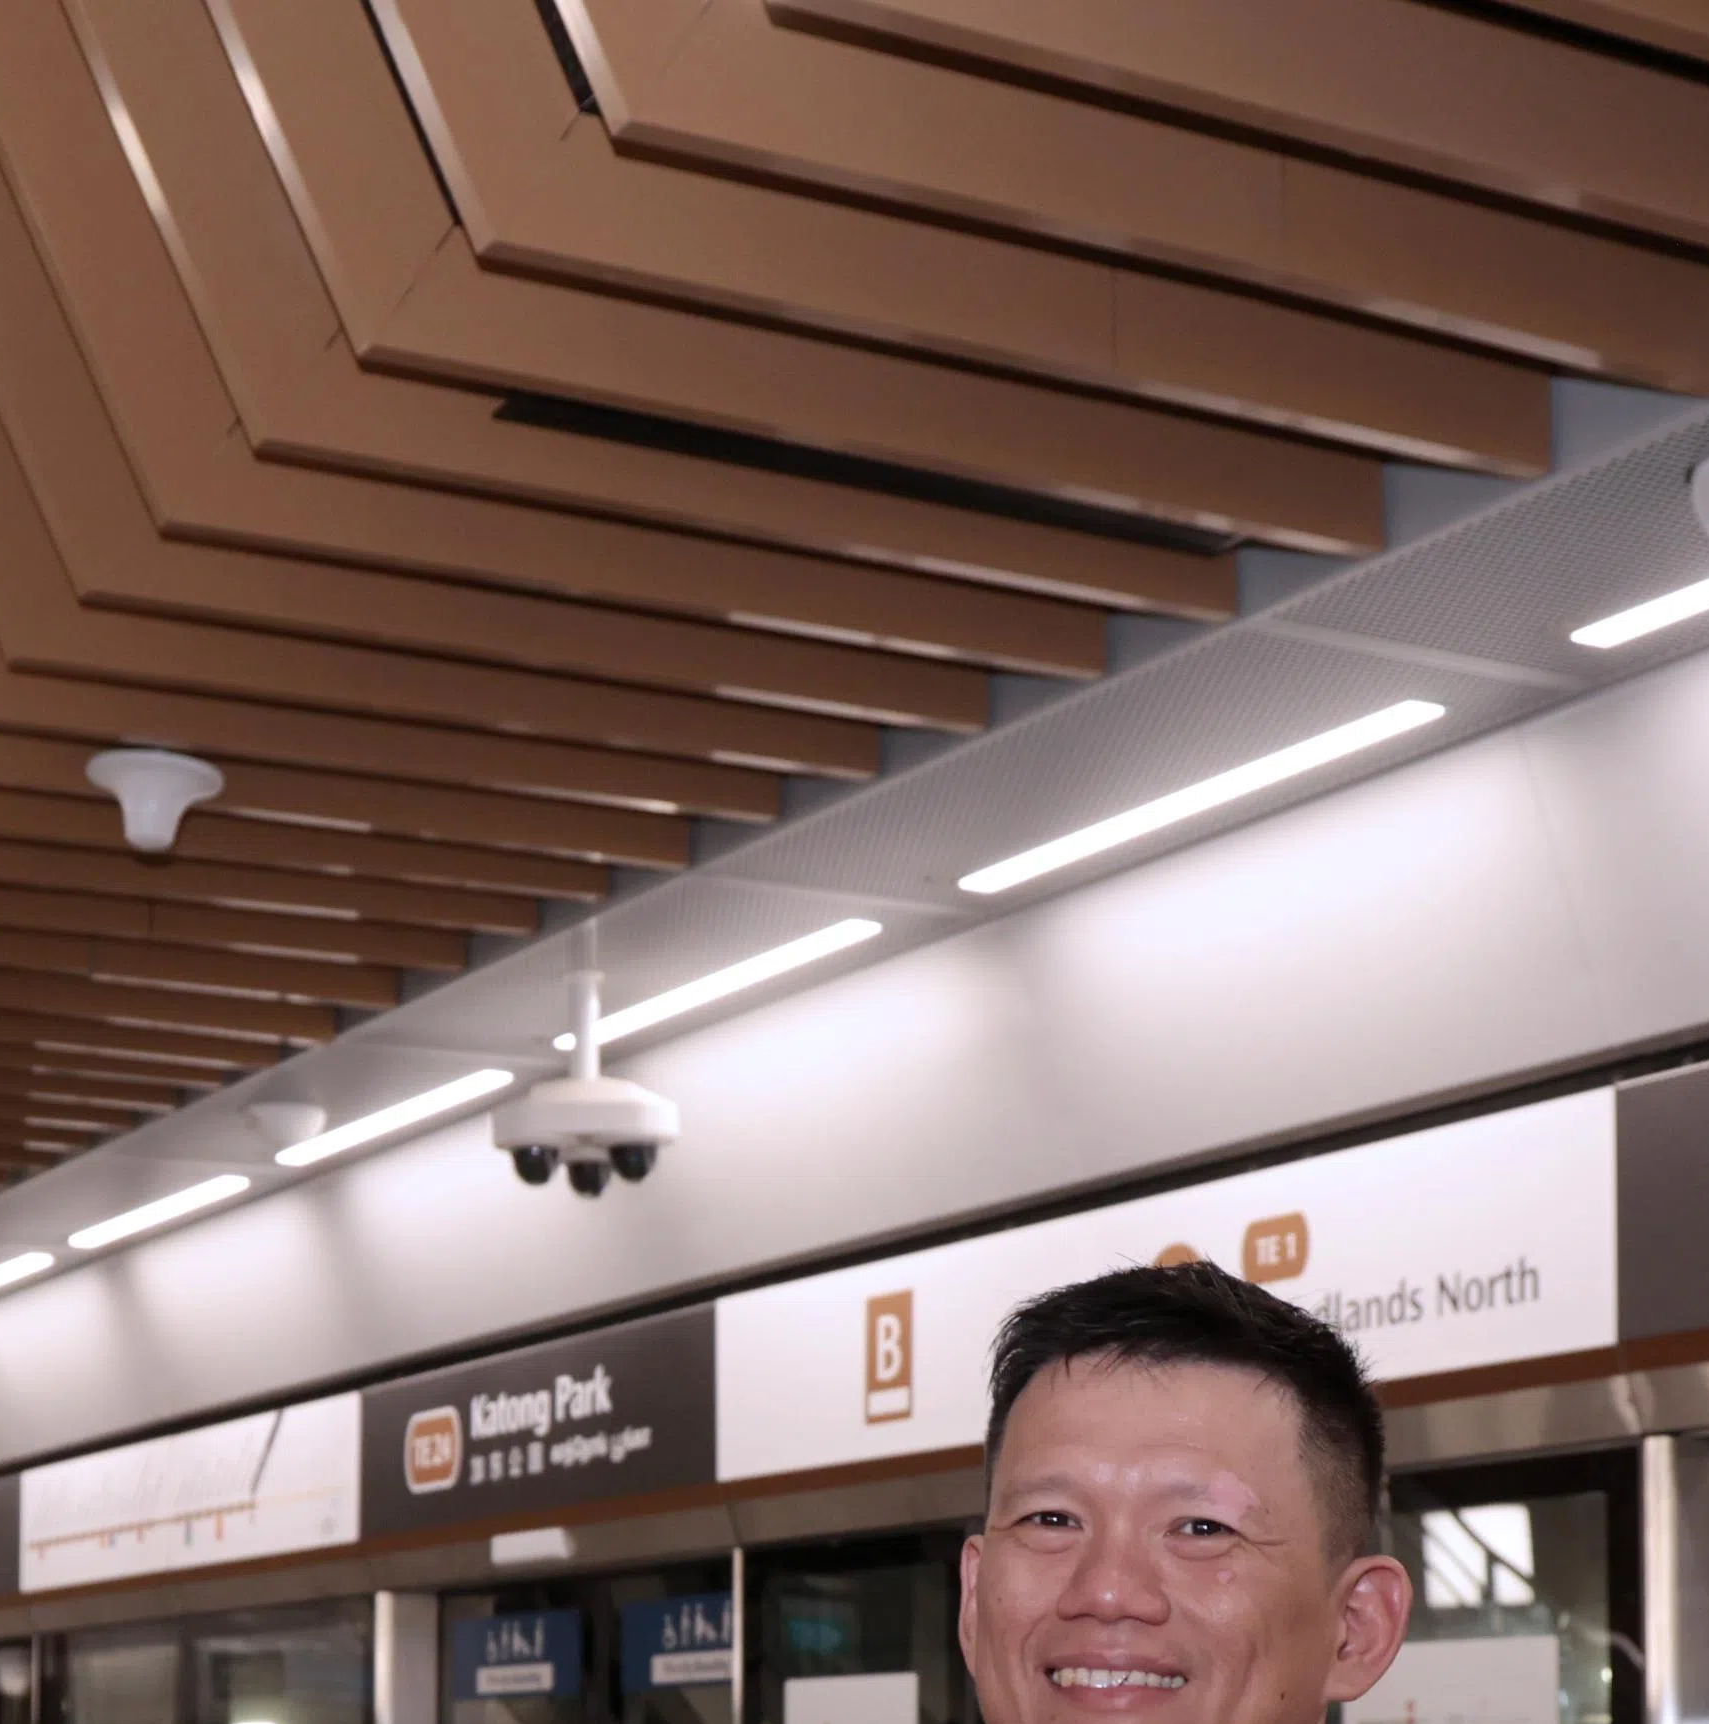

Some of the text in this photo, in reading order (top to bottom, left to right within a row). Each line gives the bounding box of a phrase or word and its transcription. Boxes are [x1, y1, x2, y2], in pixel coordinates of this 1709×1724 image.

[1309, 1256, 1541, 1332] dlands North
[875, 1312, 904, 1382] B
[470, 1362, 614, 1440] Katong Park
